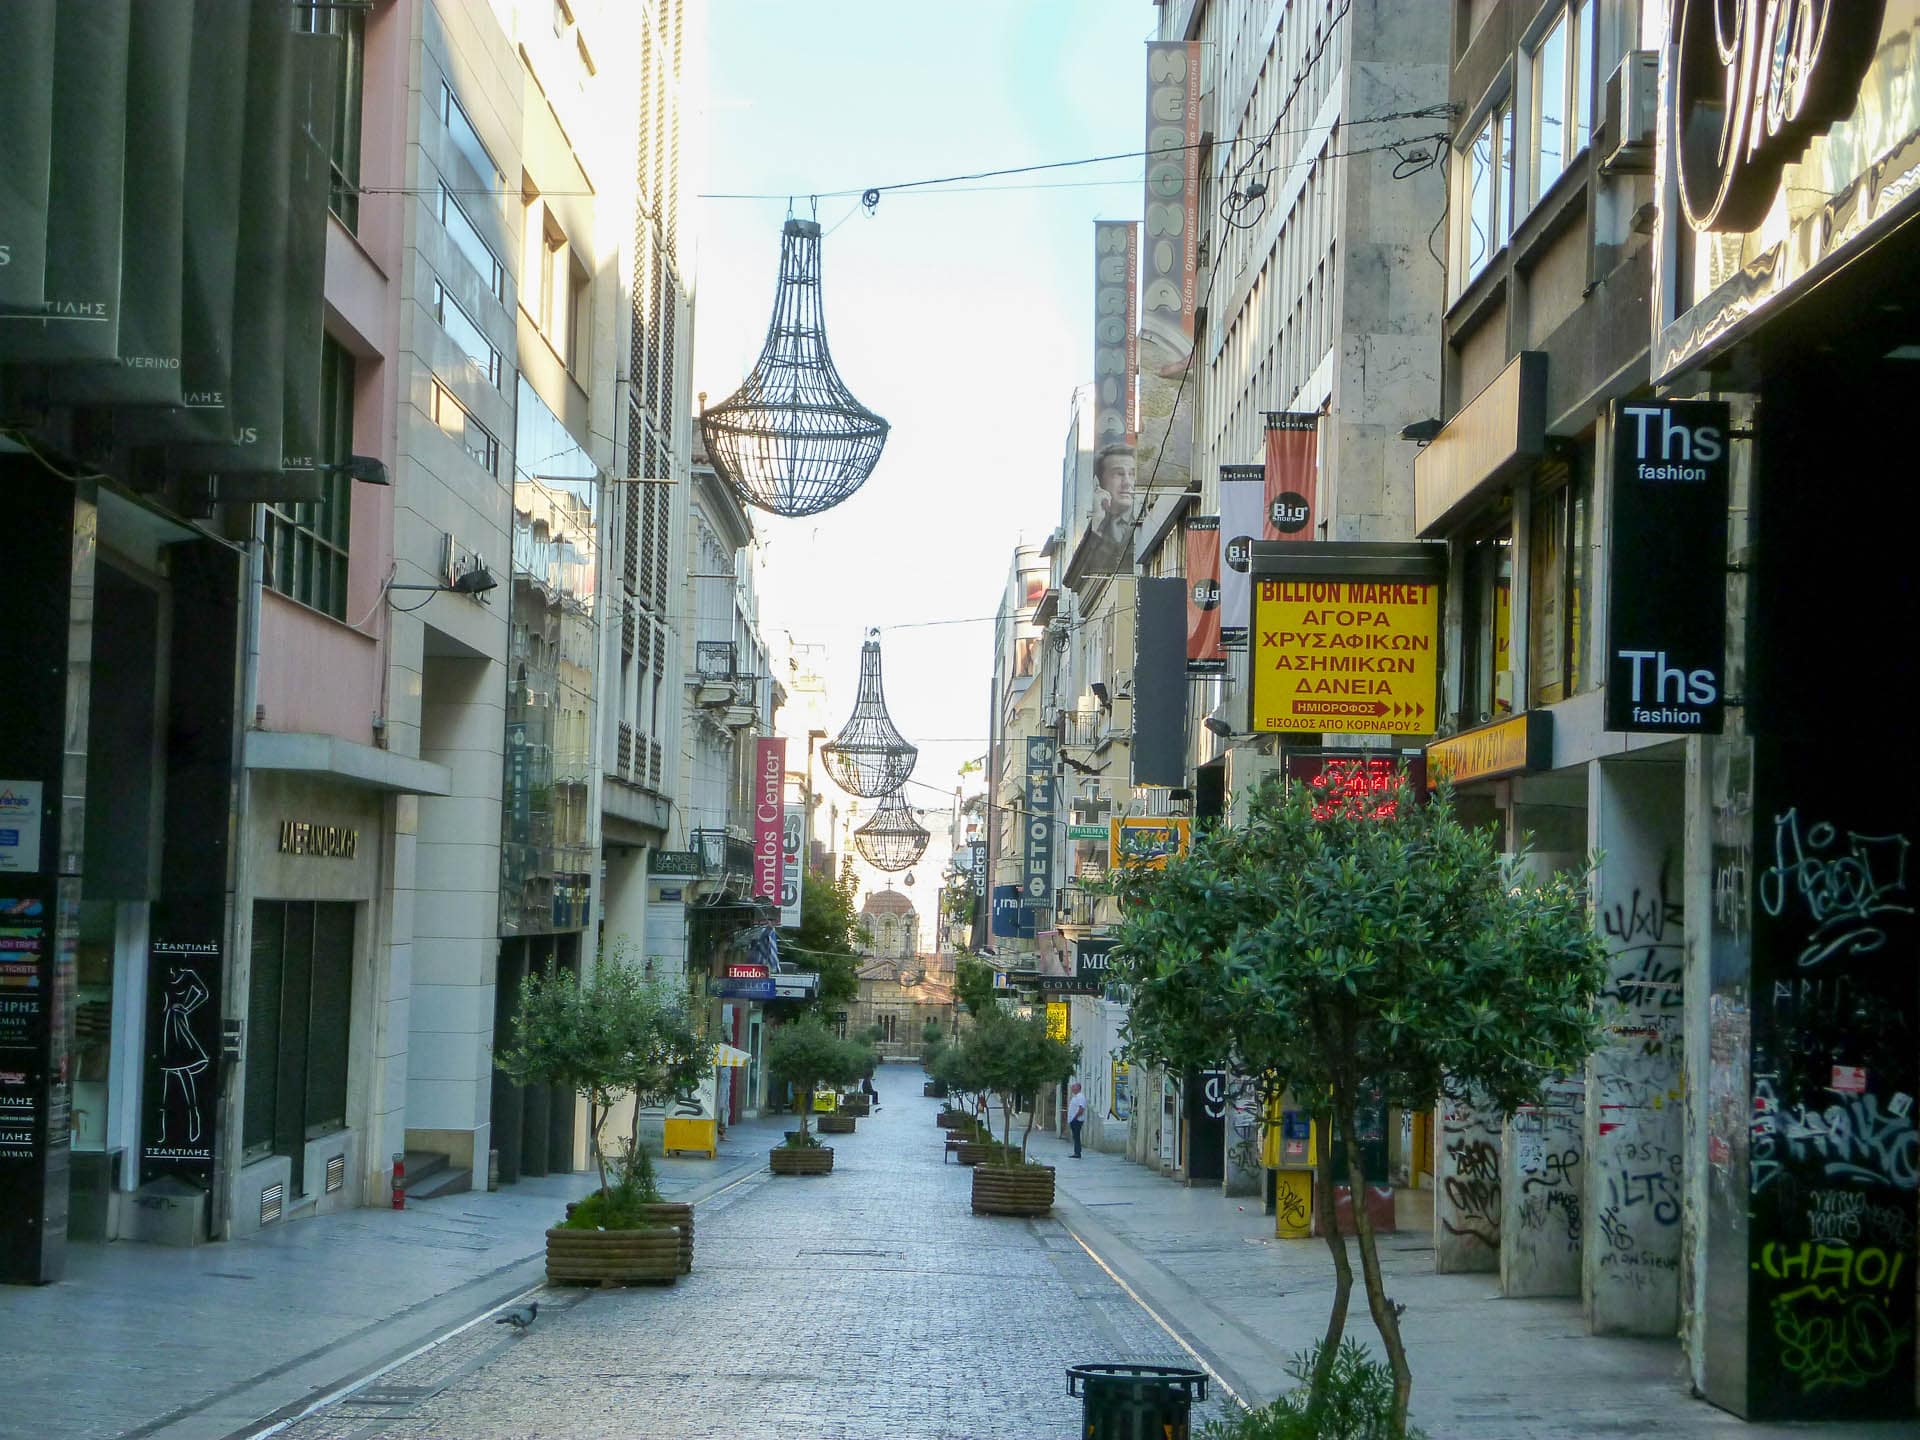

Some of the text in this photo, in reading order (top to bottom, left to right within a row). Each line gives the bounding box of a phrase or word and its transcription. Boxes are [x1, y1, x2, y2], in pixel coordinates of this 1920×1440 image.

[1624, 407, 1721, 461] Ths
[1637, 464, 1706, 480] fashion
[1274, 503, 1306, 520] Big
[1230, 546, 1248, 558] Bi
[1262, 581, 1430, 605] BILLION MARKET
[1302, 610, 1391, 627] ΑΓΟΡΑ
[1262, 632, 1429, 651] ΧΡΥΣΑΦΙΚΩΝ
[1275, 655, 1415, 673] ΑΣΗΜΙΚΩΝ
[1618, 650, 1717, 704] Ths
[1295, 678, 1393, 695] ΔΑΝΕΙΑ
[1297, 704, 1376, 715] ΗΜΙΟΡΟΦΟΣ
[1632, 706, 1701, 724] fashion
[1266, 718, 1421, 731] ΕΙΣΟΔΟΣ ΑΠΟ ΚΟΡΝΑΡΟΥ 2
[757, 750, 780, 823] Center
[973, 847, 985, 897] adidas
[154, 942, 218, 951] ΤΣΑΝΤΙΛΗΣ
[728, 967, 766, 978] Hondos
[146, 1147, 210, 1156] ΤΣΑΝΤΙΛΗΣ
